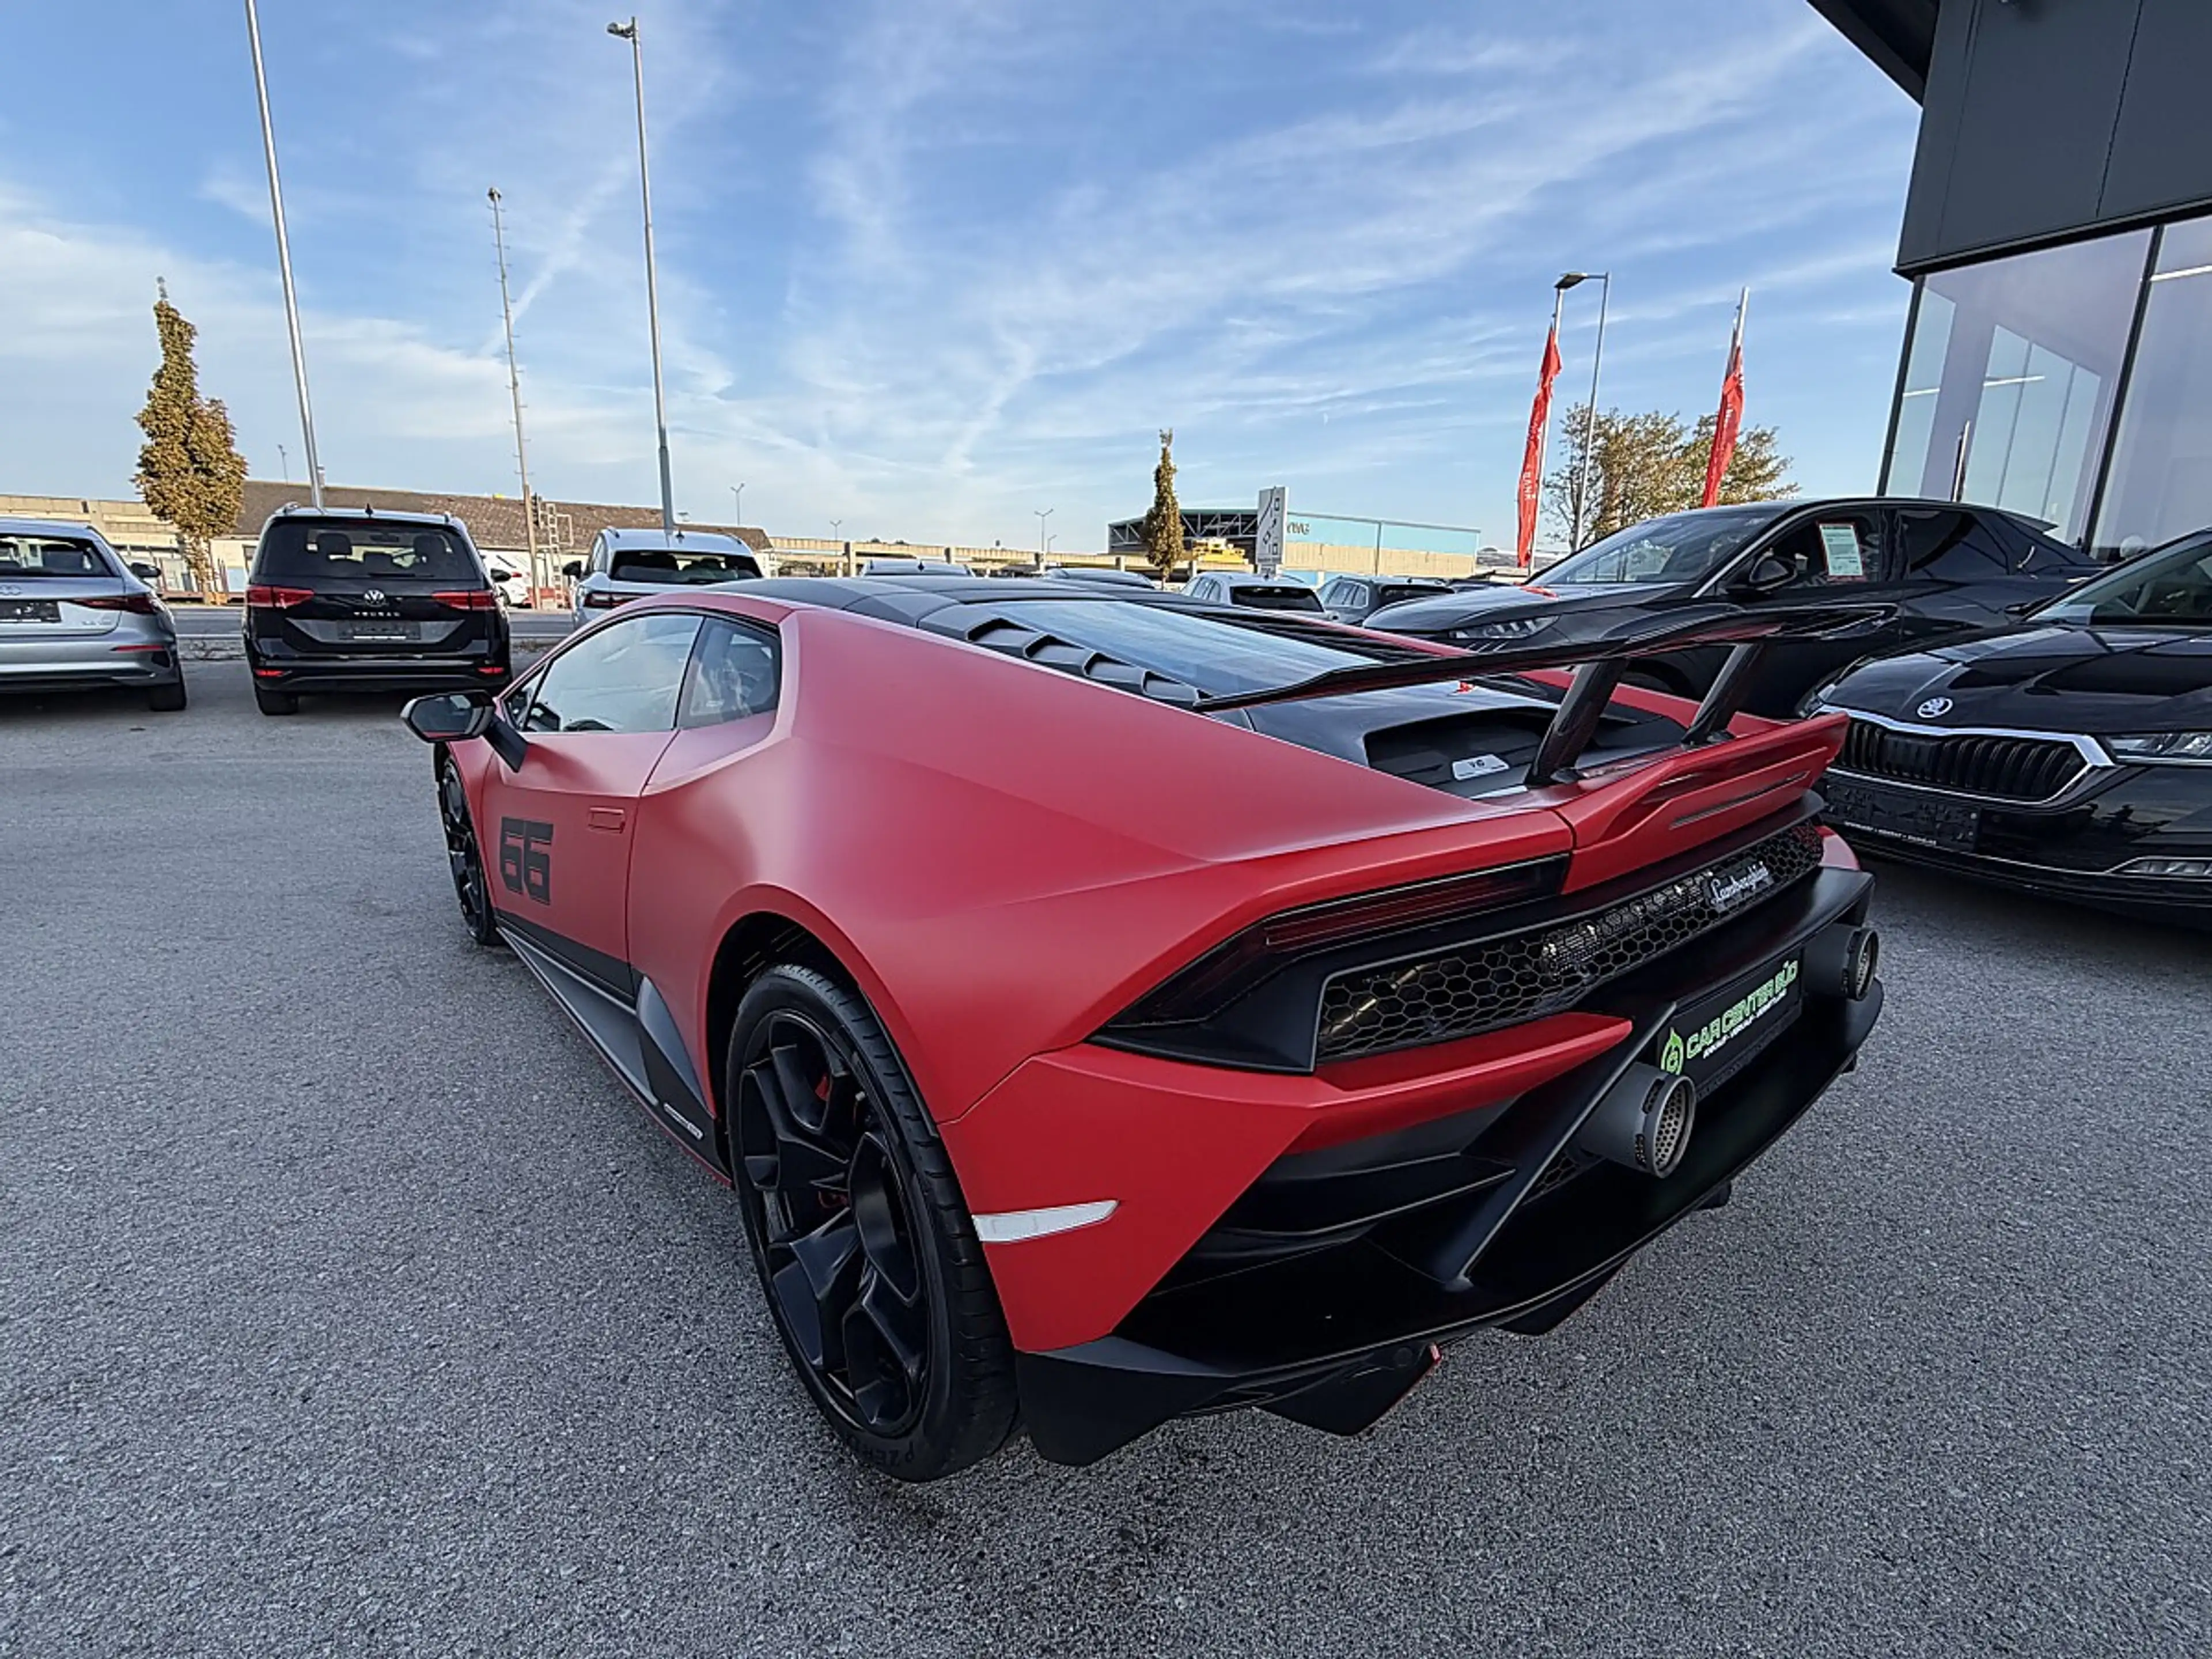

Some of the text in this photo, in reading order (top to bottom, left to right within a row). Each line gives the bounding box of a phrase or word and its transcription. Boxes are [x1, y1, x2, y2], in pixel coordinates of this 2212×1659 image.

[500, 817, 554, 906] 66
[1710, 861, 1768, 905] Lamborghini
[1686, 1017, 1721, 1059] CAR
[1721, 979, 1774, 1033] CENTER
